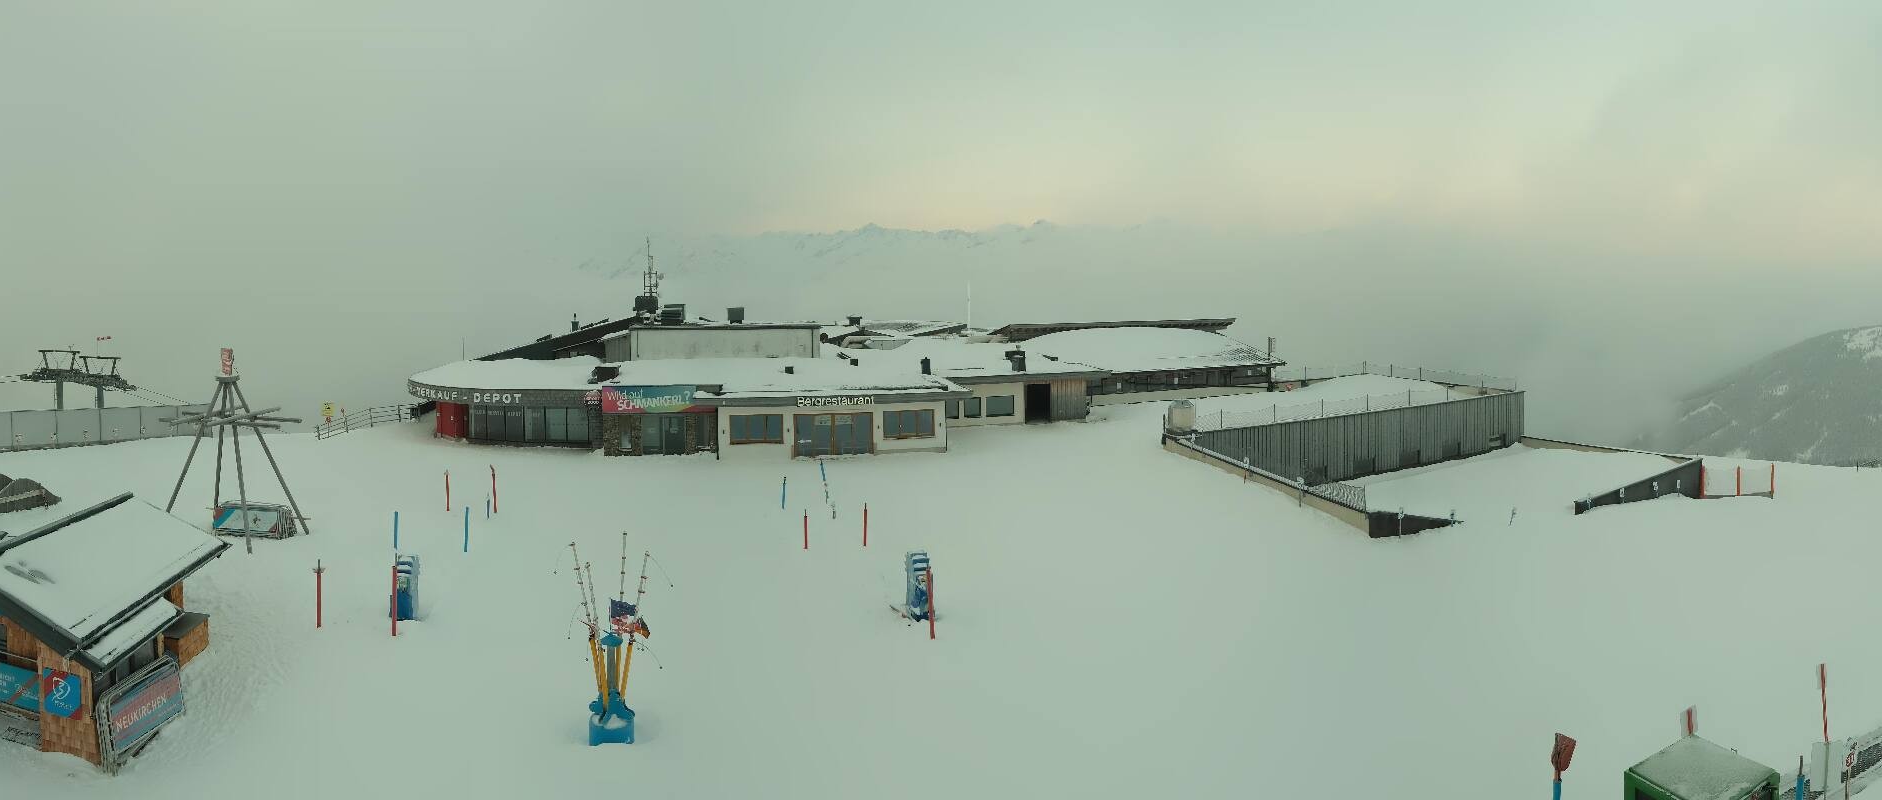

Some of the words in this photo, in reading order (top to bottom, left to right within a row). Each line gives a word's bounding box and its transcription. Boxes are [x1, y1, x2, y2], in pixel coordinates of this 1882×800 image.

[473, 392, 522, 404] DEPOT
[616, 390, 691, 411] SCHMANKERL?
[796, 396, 875, 408] Bergrestaurant
[115, 692, 167, 733] NEUKIRCHEN
